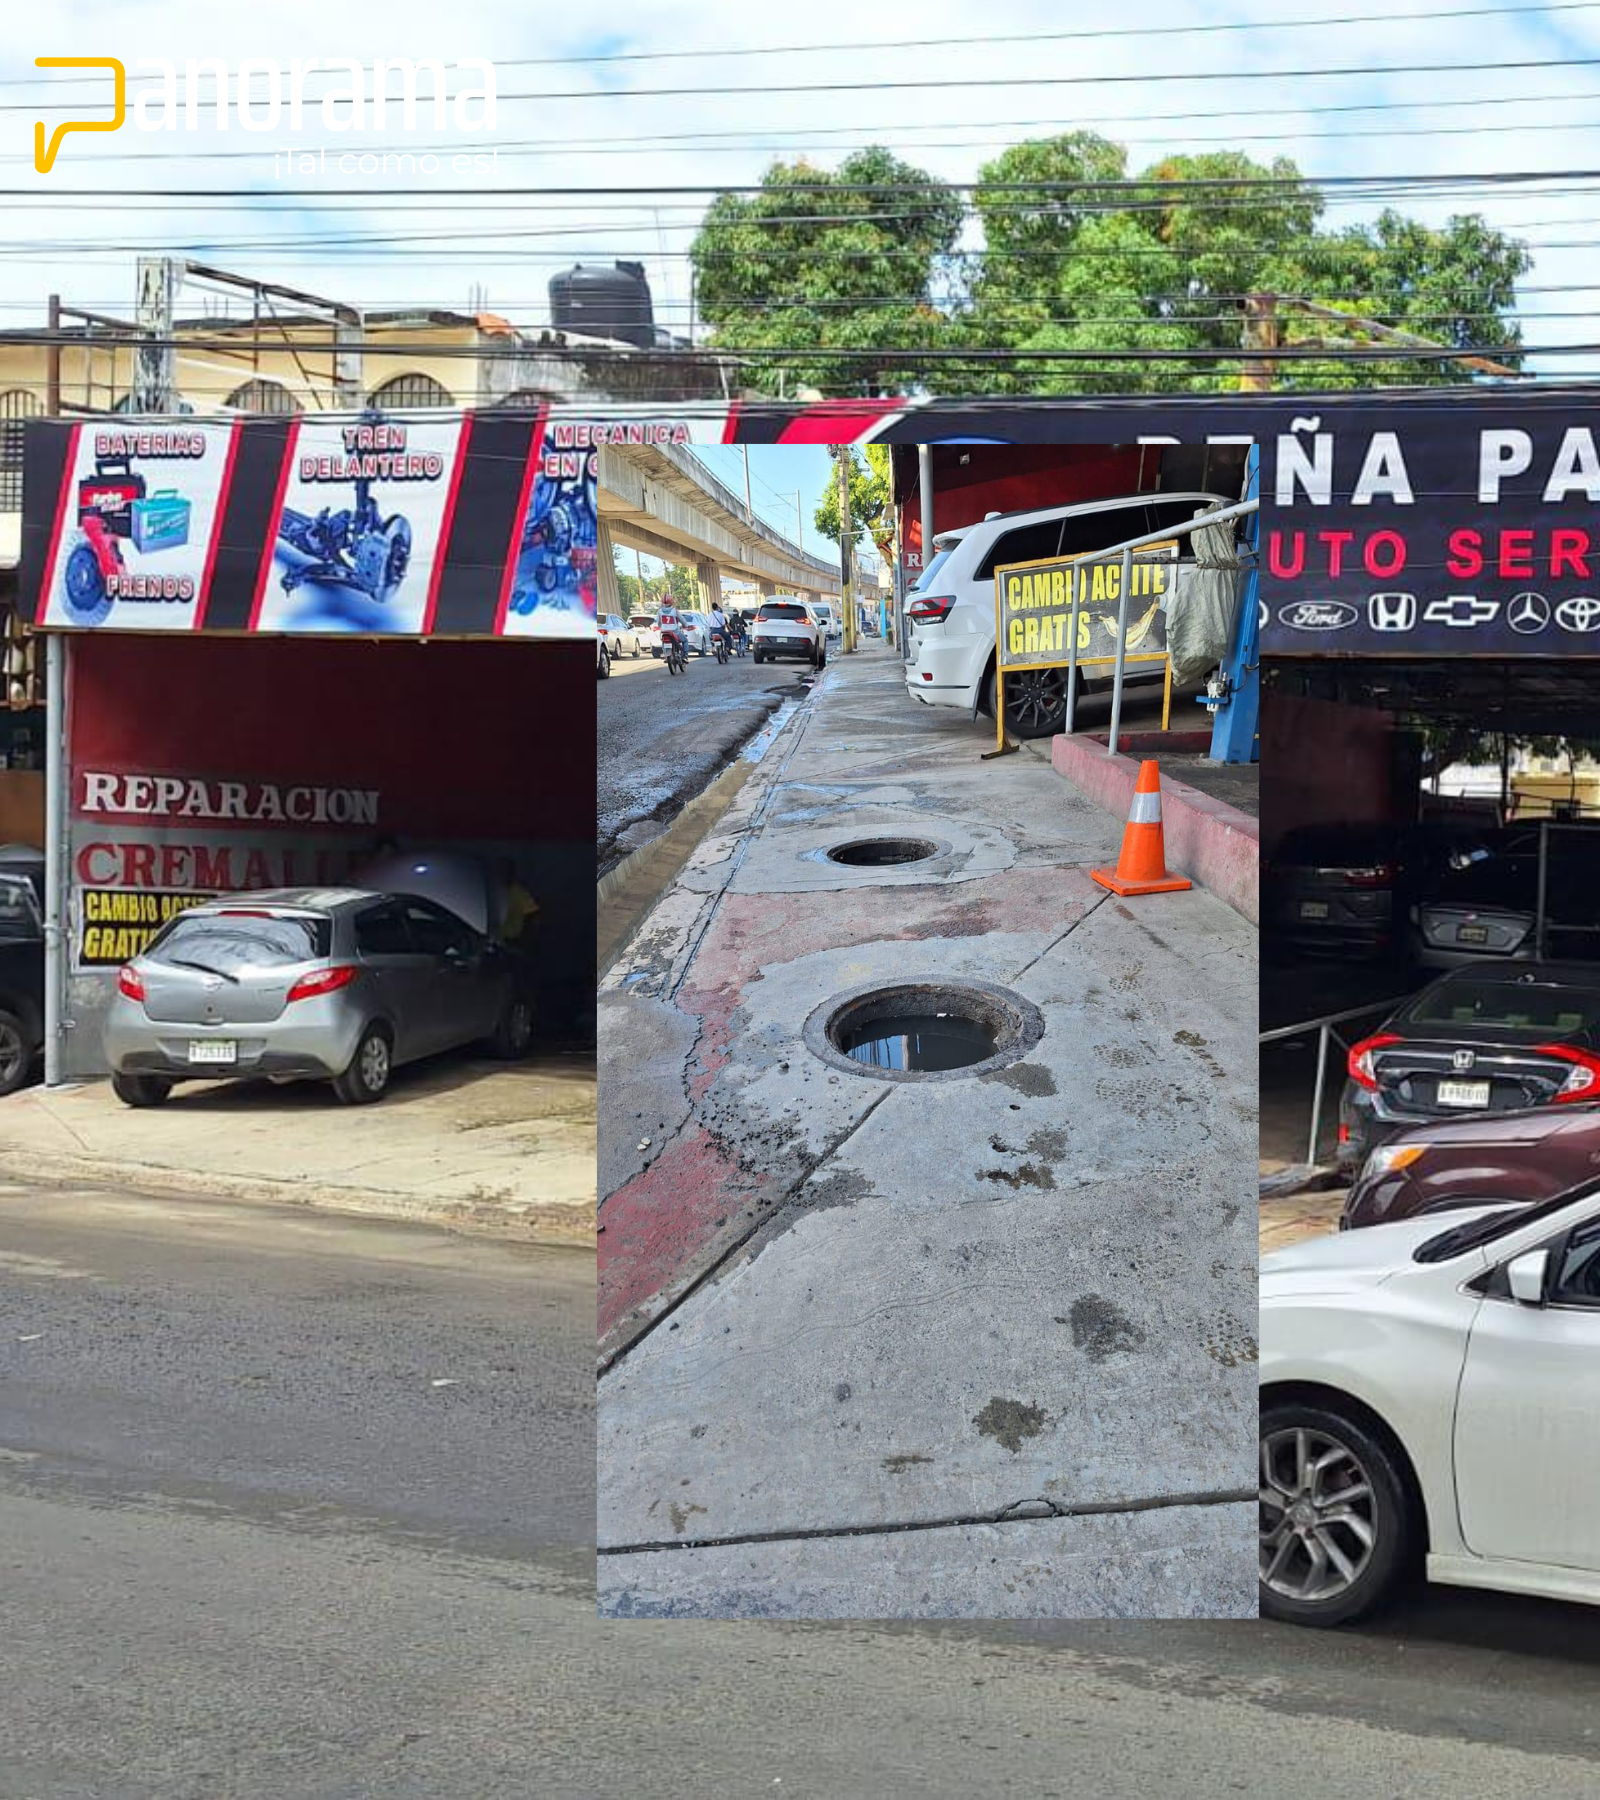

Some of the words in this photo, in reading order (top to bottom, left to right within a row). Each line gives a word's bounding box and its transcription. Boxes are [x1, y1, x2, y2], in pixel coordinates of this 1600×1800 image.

[94, 431, 207, 459] BATERIAS
[342, 426, 409, 454] TREN
[555, 422, 691, 447] MECANICA
[300, 452, 443, 482] DELANTERO
[545, 453, 580, 477] EN
[1137, 415, 1415, 506] ÑA
[1268, 530, 1408, 580] UTO
[106, 575, 196, 601] FRENOS
[1091, 564, 1165, 603] ACITE
[1009, 611, 1092, 656] GRATIS
[81, 771, 380, 827] REPARACION
[86, 891, 158, 922] CAMBIO
